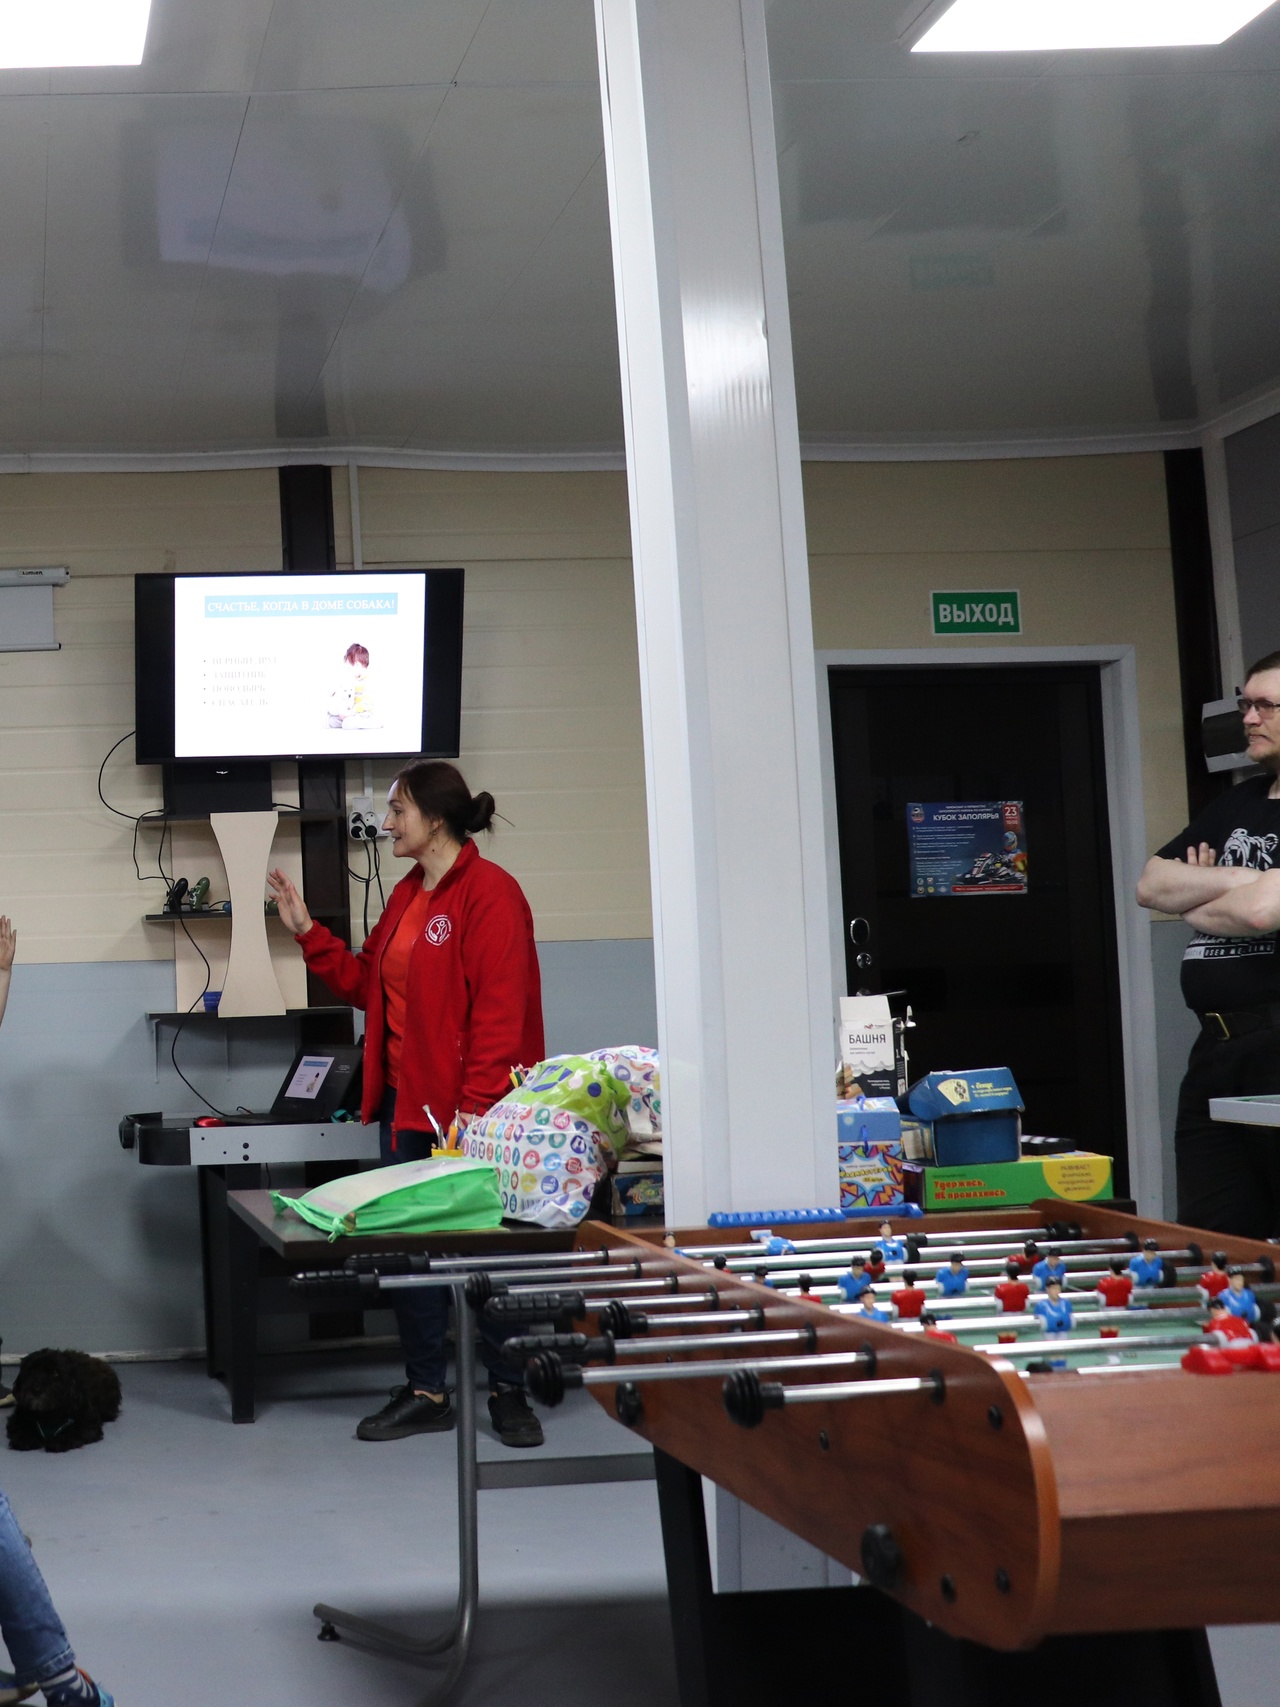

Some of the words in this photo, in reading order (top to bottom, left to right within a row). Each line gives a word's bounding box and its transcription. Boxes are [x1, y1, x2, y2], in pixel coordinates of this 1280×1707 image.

[207, 602, 260, 612] СЧАСТЬЕ,
[263, 601, 299, 612] КОГДА
[301, 601, 309, 610] В
[311, 600, 344, 611] ДОМЕ
[346, 599, 395, 610] СОБАКА!
[938, 603, 1015, 626] ВЫХОД
[1004, 806, 1017, 816] 23
[958, 813, 1000, 821] ЗАПОЛЯРЬЯ
[849, 1033, 886, 1044] БАШНЯ
[934, 1191, 946, 1200] НЕ
[947, 1189, 1007, 1200] промахнись
